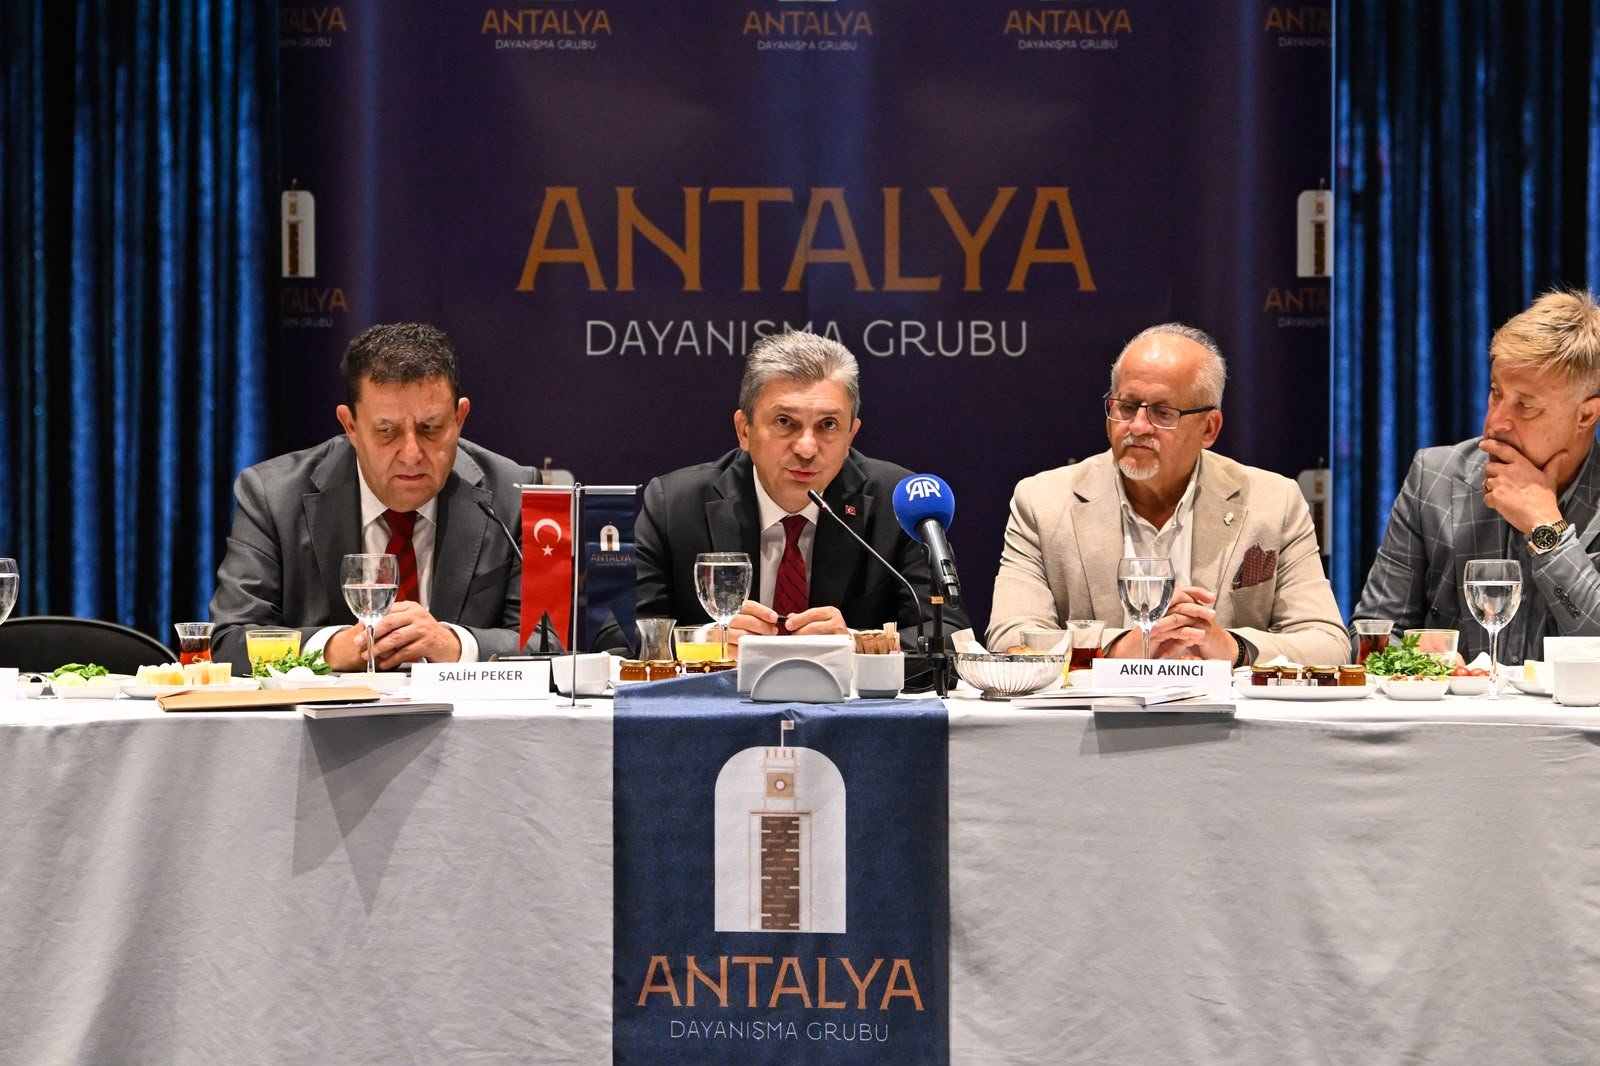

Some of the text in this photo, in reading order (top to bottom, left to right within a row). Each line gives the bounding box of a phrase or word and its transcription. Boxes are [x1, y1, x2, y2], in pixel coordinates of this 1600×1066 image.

[481, 9, 612, 35] ANTALYA
[742, 10, 873, 36] ANTALYA
[1003, 9, 1133, 34] ANTALYA
[515, 186, 1097, 292] ANTALYA
[863, 319, 1028, 357] GRUBU
[438, 668, 523, 681] SALİH PEKER
[1120, 663, 1204, 677] AKIN AKINCI
[635, 954, 926, 1012] ANTALYA
[669, 1020, 889, 1043] DAYANIŞMA GRUBU
